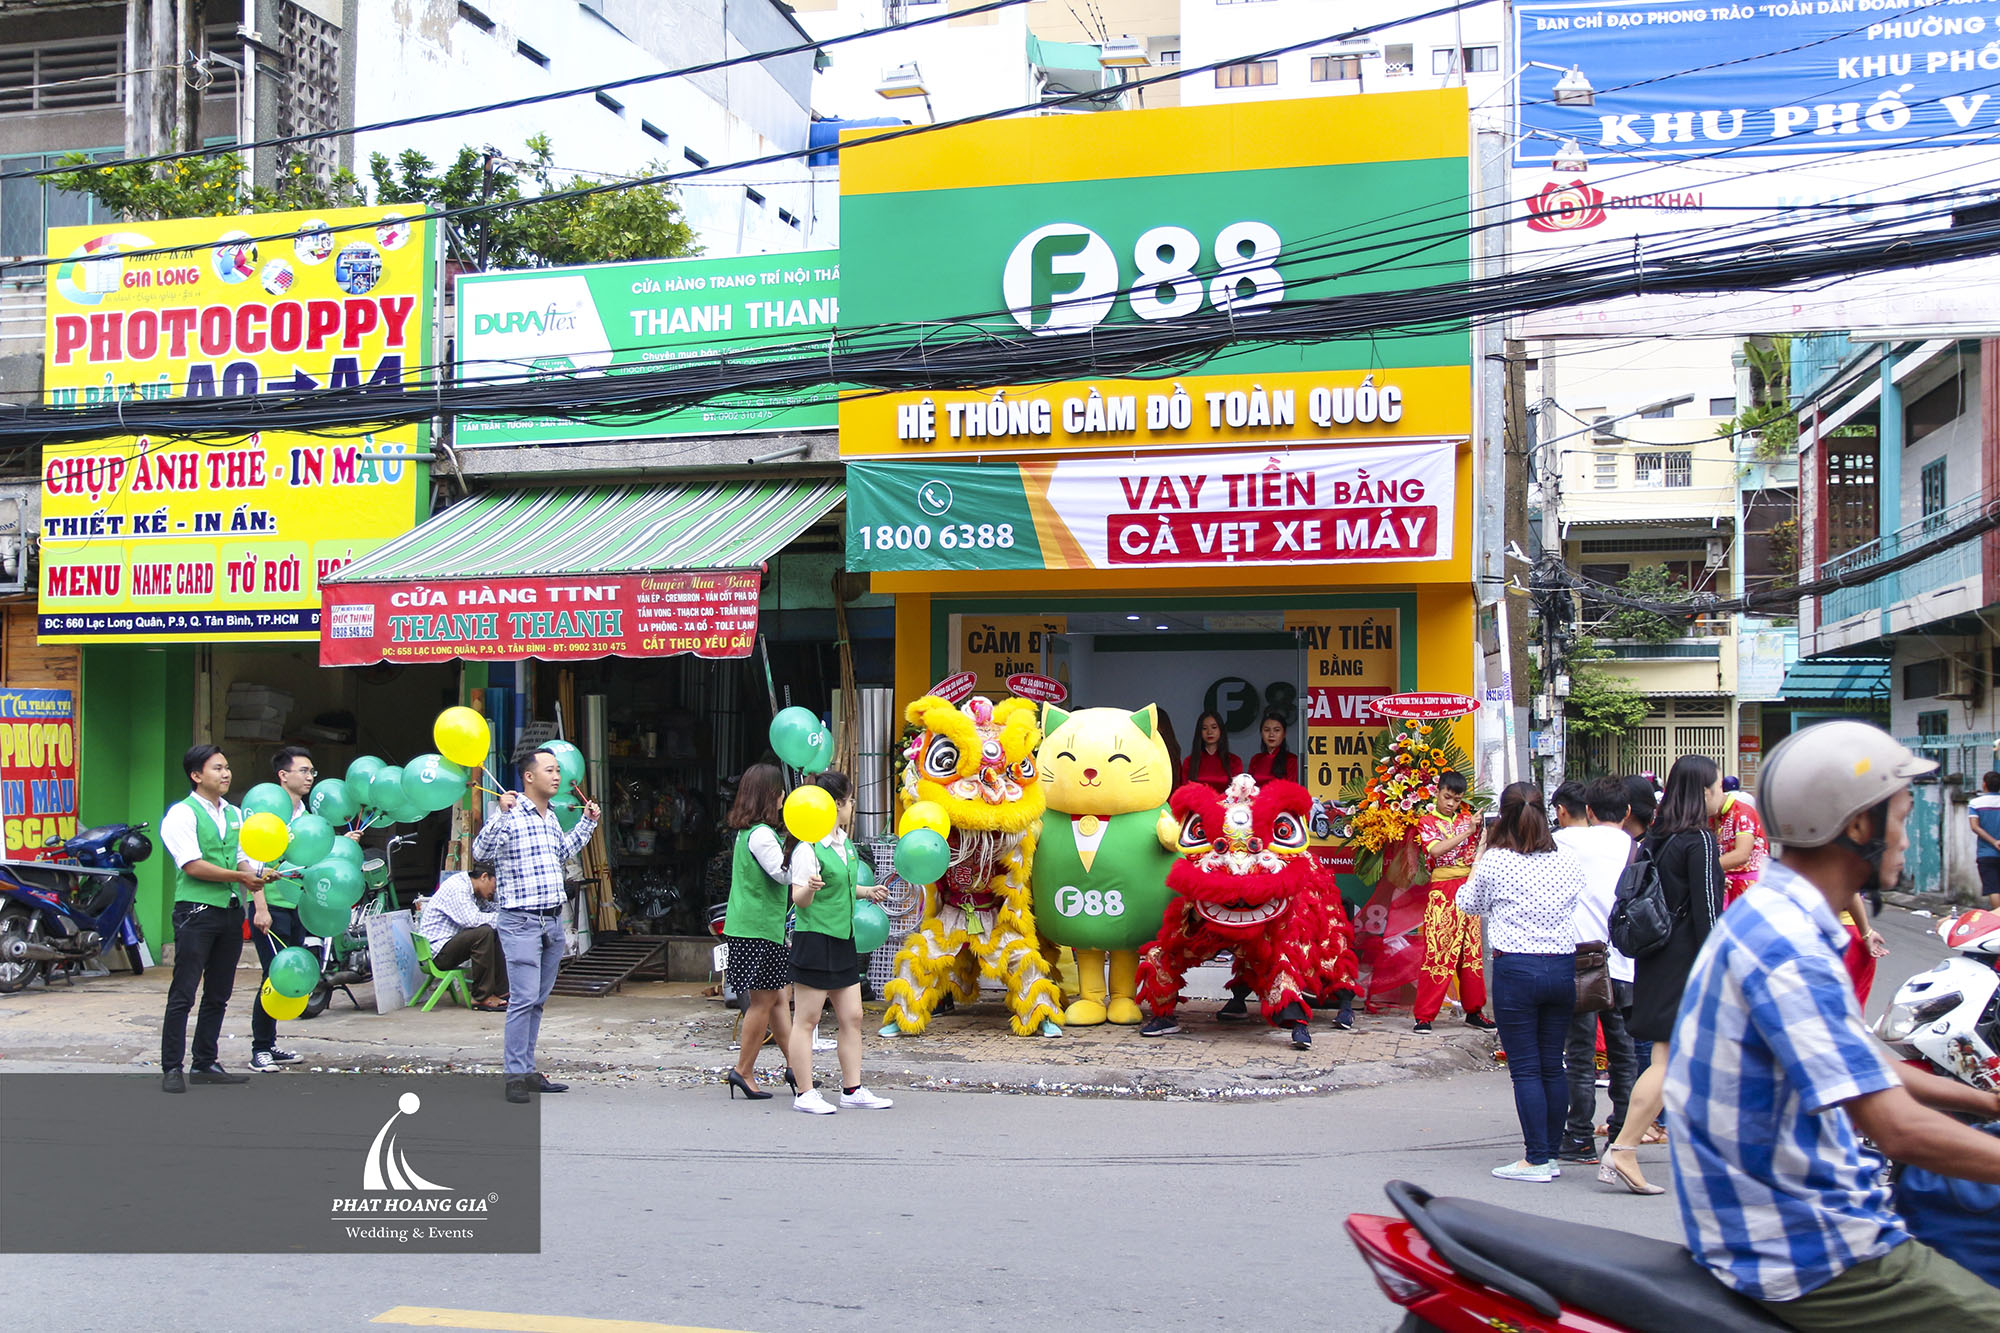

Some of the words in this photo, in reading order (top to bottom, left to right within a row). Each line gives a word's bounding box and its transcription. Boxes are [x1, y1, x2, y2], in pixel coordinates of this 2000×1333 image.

[1536, 17, 1569, 31] BAN
[1573, 11, 1602, 30] CHỈ
[1606, 15, 1643, 30] ĐẠO
[1647, 8, 1707, 24] PHONG
[1711, 3, 1755, 21] TRÀO
[1867, 15, 1986, 41] PHƯỜNG
[1837, 53, 1912, 80] KHU
[1599, 108, 1748, 146] KHU
[1769, 83, 1915, 138] PHỐ
[123, 271, 152, 288] GIA
[156, 267, 200, 286] LONG
[631, 278, 662, 295] CỬA
[665, 275, 706, 292] HÀNG
[709, 273, 757, 288] TRANG
[760, 267, 781, 285] TRÍ
[784, 267, 811, 285] NỘI
[1003, 223, 1284, 336] F88
[54, 297, 414, 364] PHOTOCOPPY
[630, 304, 733, 337] THANH
[642, 349, 676, 361] Chuyên
[898, 399, 936, 442] HỆ
[947, 391, 1052, 437] THỐNG
[1063, 387, 1136, 434] CẦM
[1146, 384, 1191, 430] ĐỒ
[1206, 384, 1295, 428] TOÀN
[1309, 375, 1403, 424] QUỐC
[45, 457, 125, 501] CHỤP
[132, 439, 202, 491] ẢNH
[207, 434, 266, 489] THẺ
[291, 448, 324, 487] IN
[333, 434, 404, 484] MÀU
[1121, 475, 1205, 510] VAY
[1222, 457, 1316, 508] TIỀN
[1334, 470, 1425, 504] BẰNG
[44, 507, 124, 537] THIẾT
[133, 505, 167, 534] KẾ
[195, 512, 221, 531] IN
[231, 504, 277, 531] ẤN:
[1119, 515, 1178, 556] CÀ
[1191, 522, 1260, 555] VẸT
[1271, 521, 1323, 552] XE
[1335, 507, 1426, 550] MÁY
[859, 525, 931, 550] 1800
[938, 523, 1015, 550] 6388
[48, 563, 122, 597] MENU
[133, 564, 173, 595] NAME
[176, 563, 214, 595] CARD
[228, 551, 257, 593] TỜ
[264, 554, 300, 592] RƠI
[390, 585, 446, 607] CỬA
[458, 581, 537, 604] HÀNG
[545, 585, 622, 602] TTNT
[45, 619, 64, 629] ĐC:
[66, 618, 84, 628] 660
[87, 617, 105, 630] Lạc
[108, 616, 133, 630] Long
[135, 615, 166, 630] Quân,
[168, 616, 188, 629] P.9,
[190, 616, 202, 628] Q.
[204, 614, 224, 626] Tân
[226, 613, 254, 627] Bình,
[256, 614, 299, 625] TP.HCM
[388, 613, 498, 642] THANH
[507, 609, 624, 639] THANH
[638, 623, 649, 633] LA
[684, 623, 695, 632] XA
[714, 621, 735, 631] TOLE
[700, 607, 714, 617] CAO
[382, 647, 396, 656] ĐC:
[397, 646, 412, 656] 658
[414, 647, 430, 656] LẠC
[431, 645, 453, 654] LONG
[497, 645, 506, 653] Q.
[508, 642, 524, 653] TÂN
[526, 642, 546, 652] BÌNH
[553, 643, 567, 652] ĐT:
[569, 642, 590, 651] 0902
[592, 642, 608, 651] 310
[610, 642, 627, 650] 475
[643, 633, 665, 650] CẮT
[669, 638, 702, 649] THEO
[704, 634, 728, 649] YÊU
[731, 632, 752, 648] CẦU
[968, 624, 1020, 654] CẦM
[1339, 617, 1392, 650] TIỀN
[1320, 654, 1363, 676] BẰNG
[0, 723, 73, 768] PHOTO
[1318, 763, 1332, 786] Ô
[3, 780, 25, 816] IN
[31, 770, 74, 814] MÀU
[5, 816, 76, 850] SCAN
[1054, 885, 1125, 917] F88
